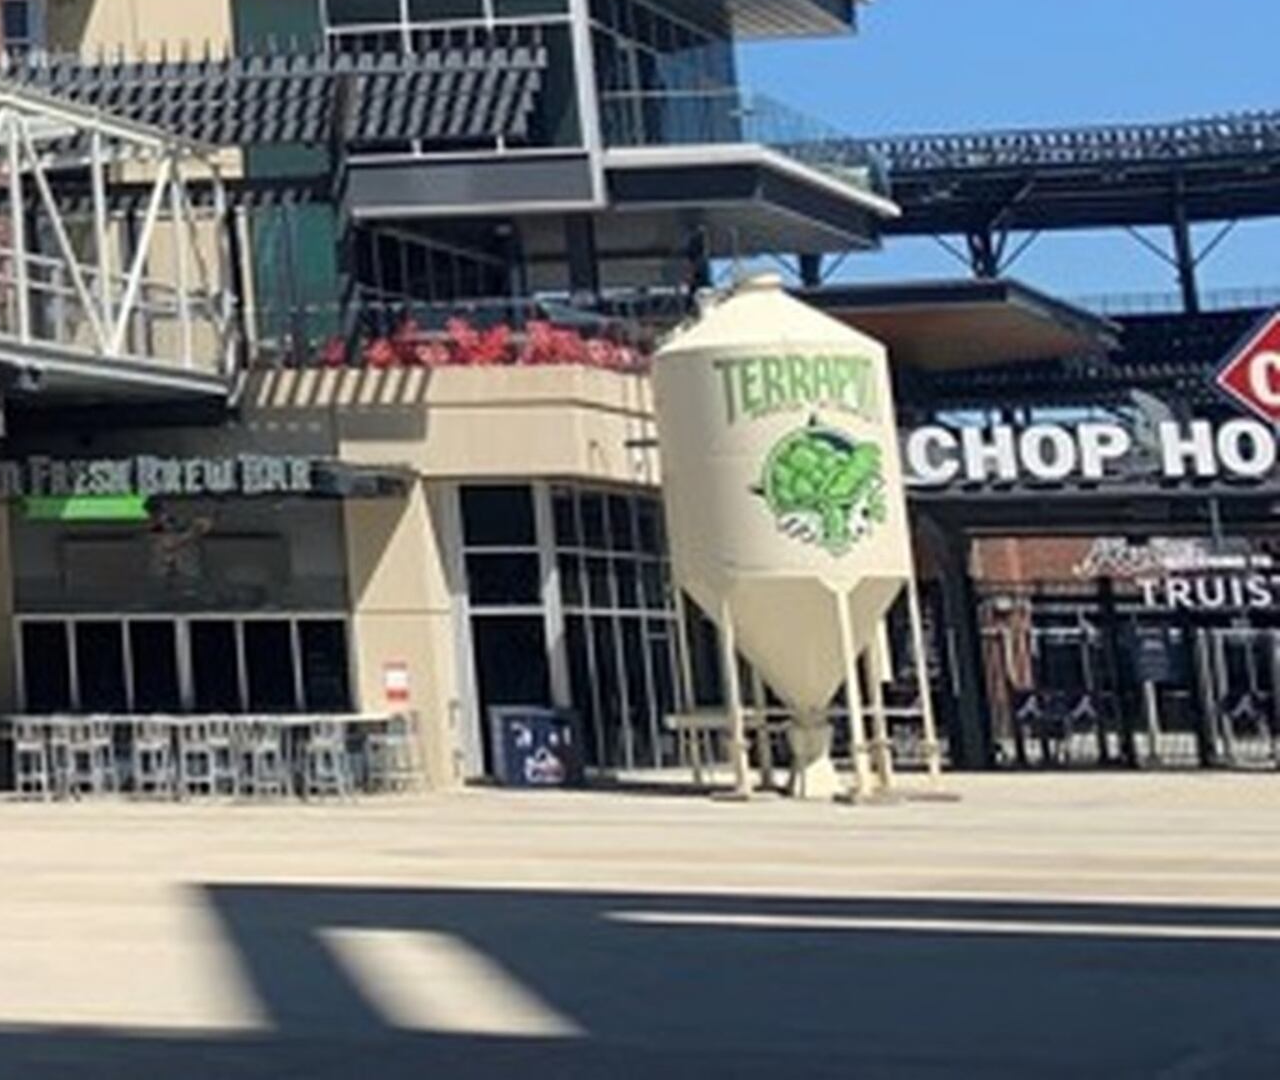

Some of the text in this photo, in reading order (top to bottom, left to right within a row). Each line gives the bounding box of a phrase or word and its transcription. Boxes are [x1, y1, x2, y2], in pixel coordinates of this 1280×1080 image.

[906, 420, 1132, 487] CHOP
[136, 454, 235, 496] BREW
[239, 454, 312, 495] BAR
[1136, 575, 1280, 609] TRUIS
